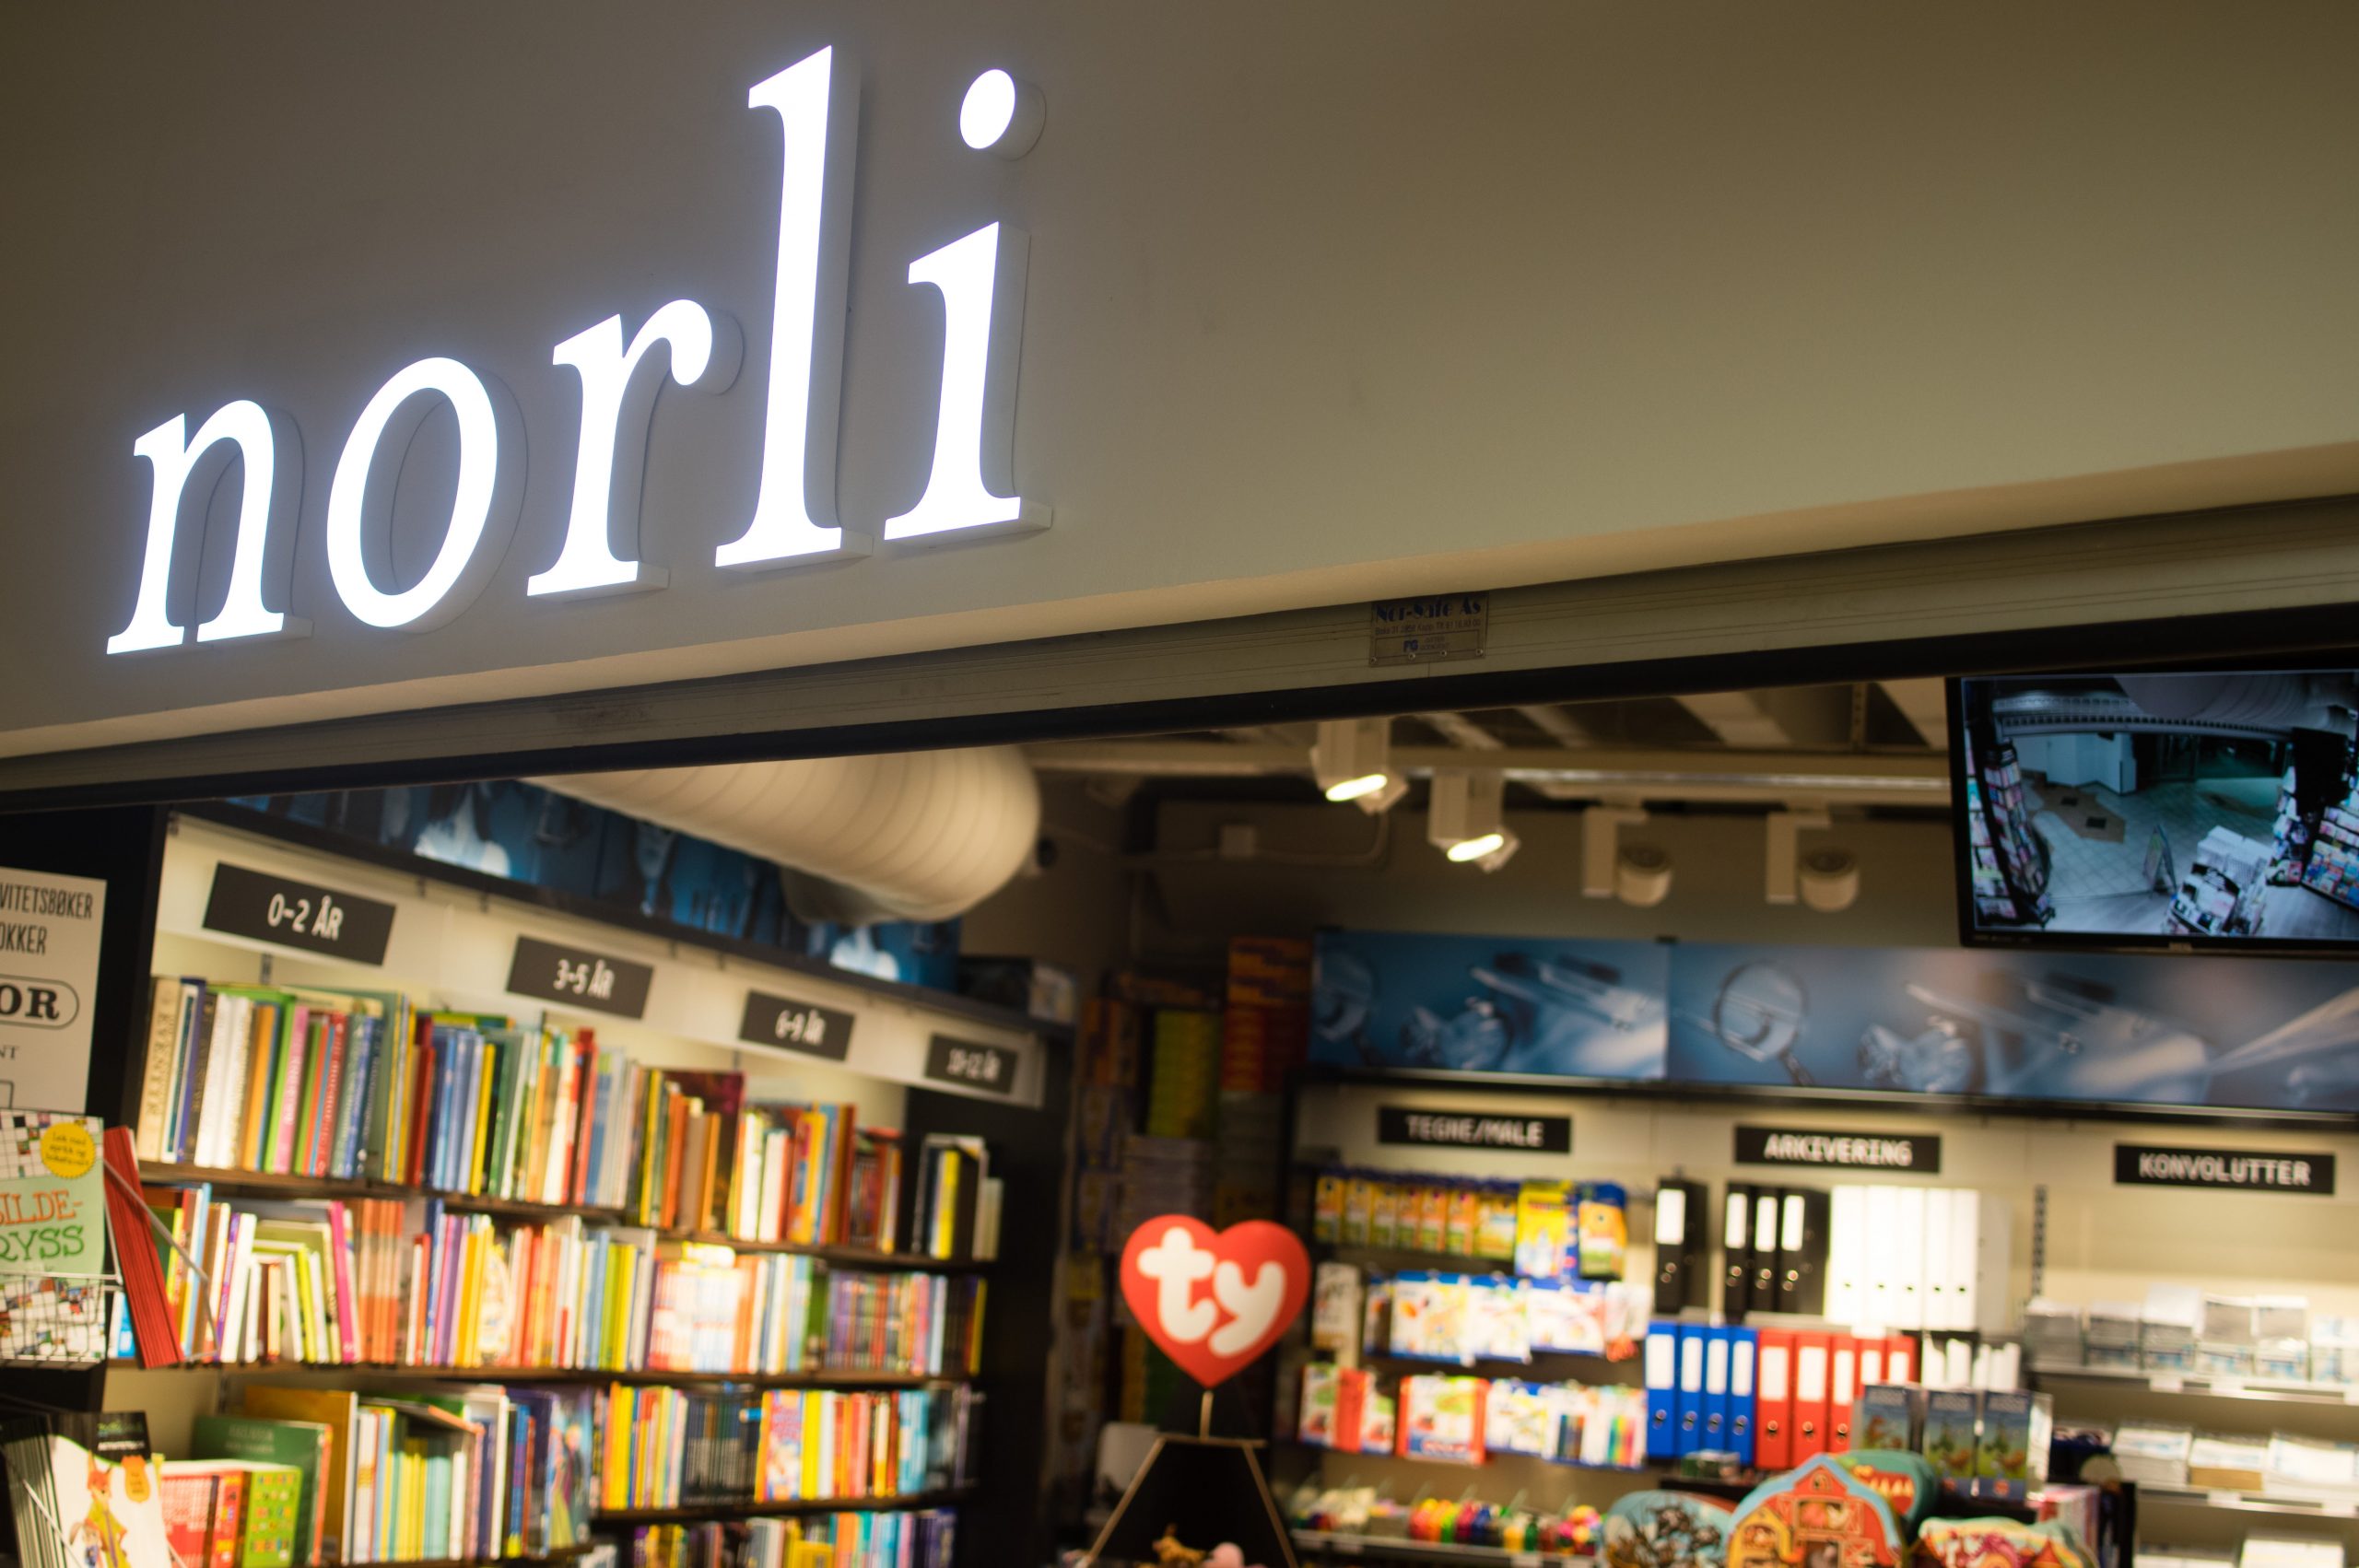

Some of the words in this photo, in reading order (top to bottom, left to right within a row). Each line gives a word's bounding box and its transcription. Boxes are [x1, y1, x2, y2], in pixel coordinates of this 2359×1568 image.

[106, 45, 1022, 655] norli
[0, 883, 93, 919] VITETSBØKER
[267, 894, 311, 931] 0-2
[311, 895, 344, 940] ÅR
[554, 959, 589, 995] 3-5
[587, 960, 615, 1000] ÅR
[0, 984, 60, 1020] OR
[775, 1010, 804, 1039] 6-9
[1764, 1133, 1913, 1167] ARKIVERING
[2139, 1153, 2311, 1186] KONVOLUTTER
[1137, 1226, 1286, 1358] ty
